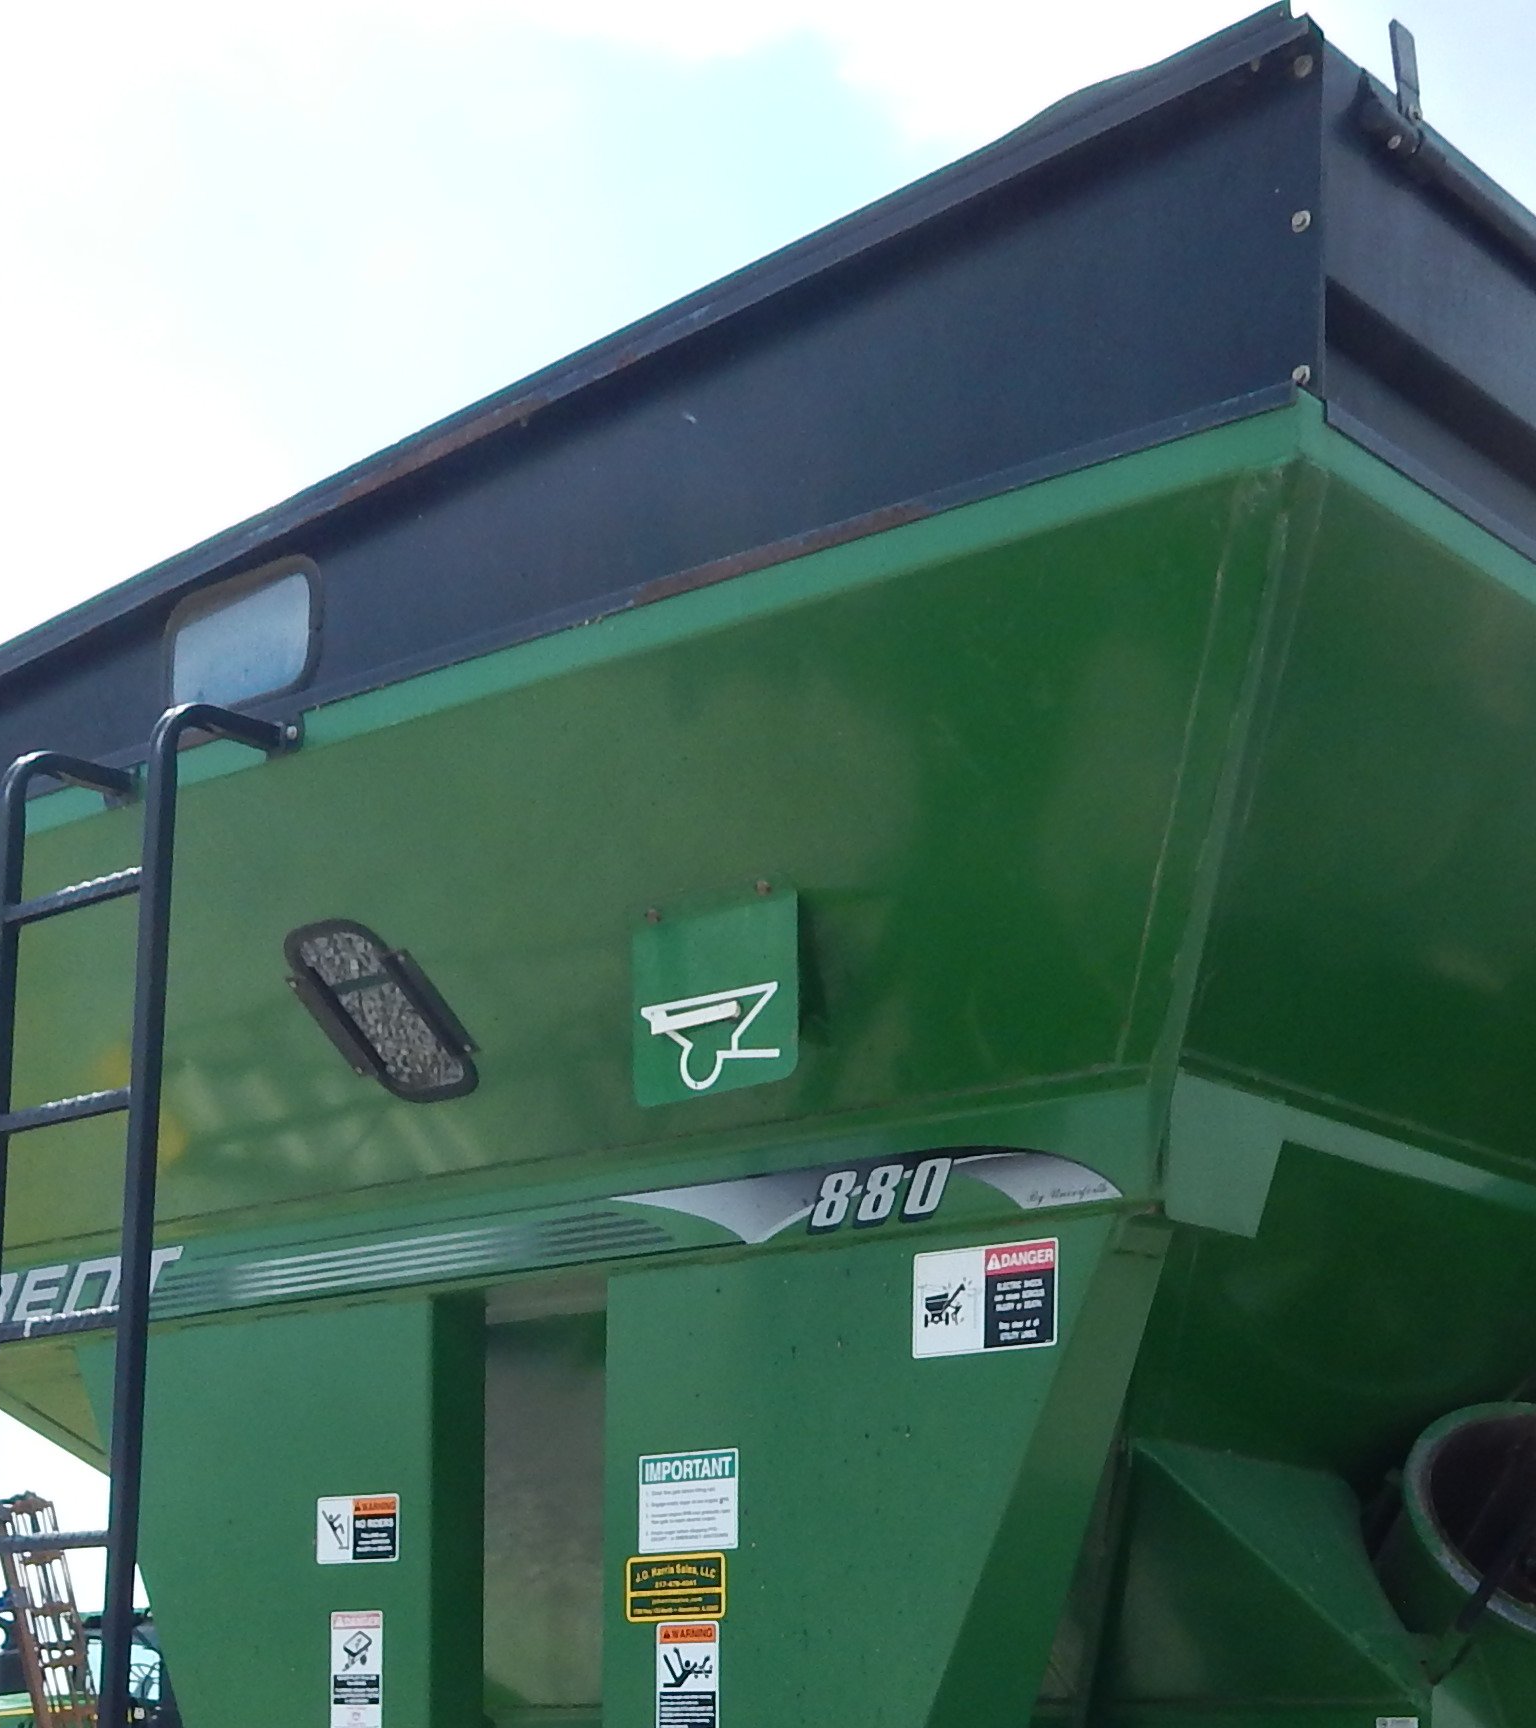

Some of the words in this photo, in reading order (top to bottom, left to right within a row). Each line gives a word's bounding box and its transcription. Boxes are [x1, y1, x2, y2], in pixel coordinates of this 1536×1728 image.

[811, 1157, 952, 1228] 880
[1001, 1248, 1054, 1269] DANGER
[644, 1456, 733, 1482] IMPORTANT
